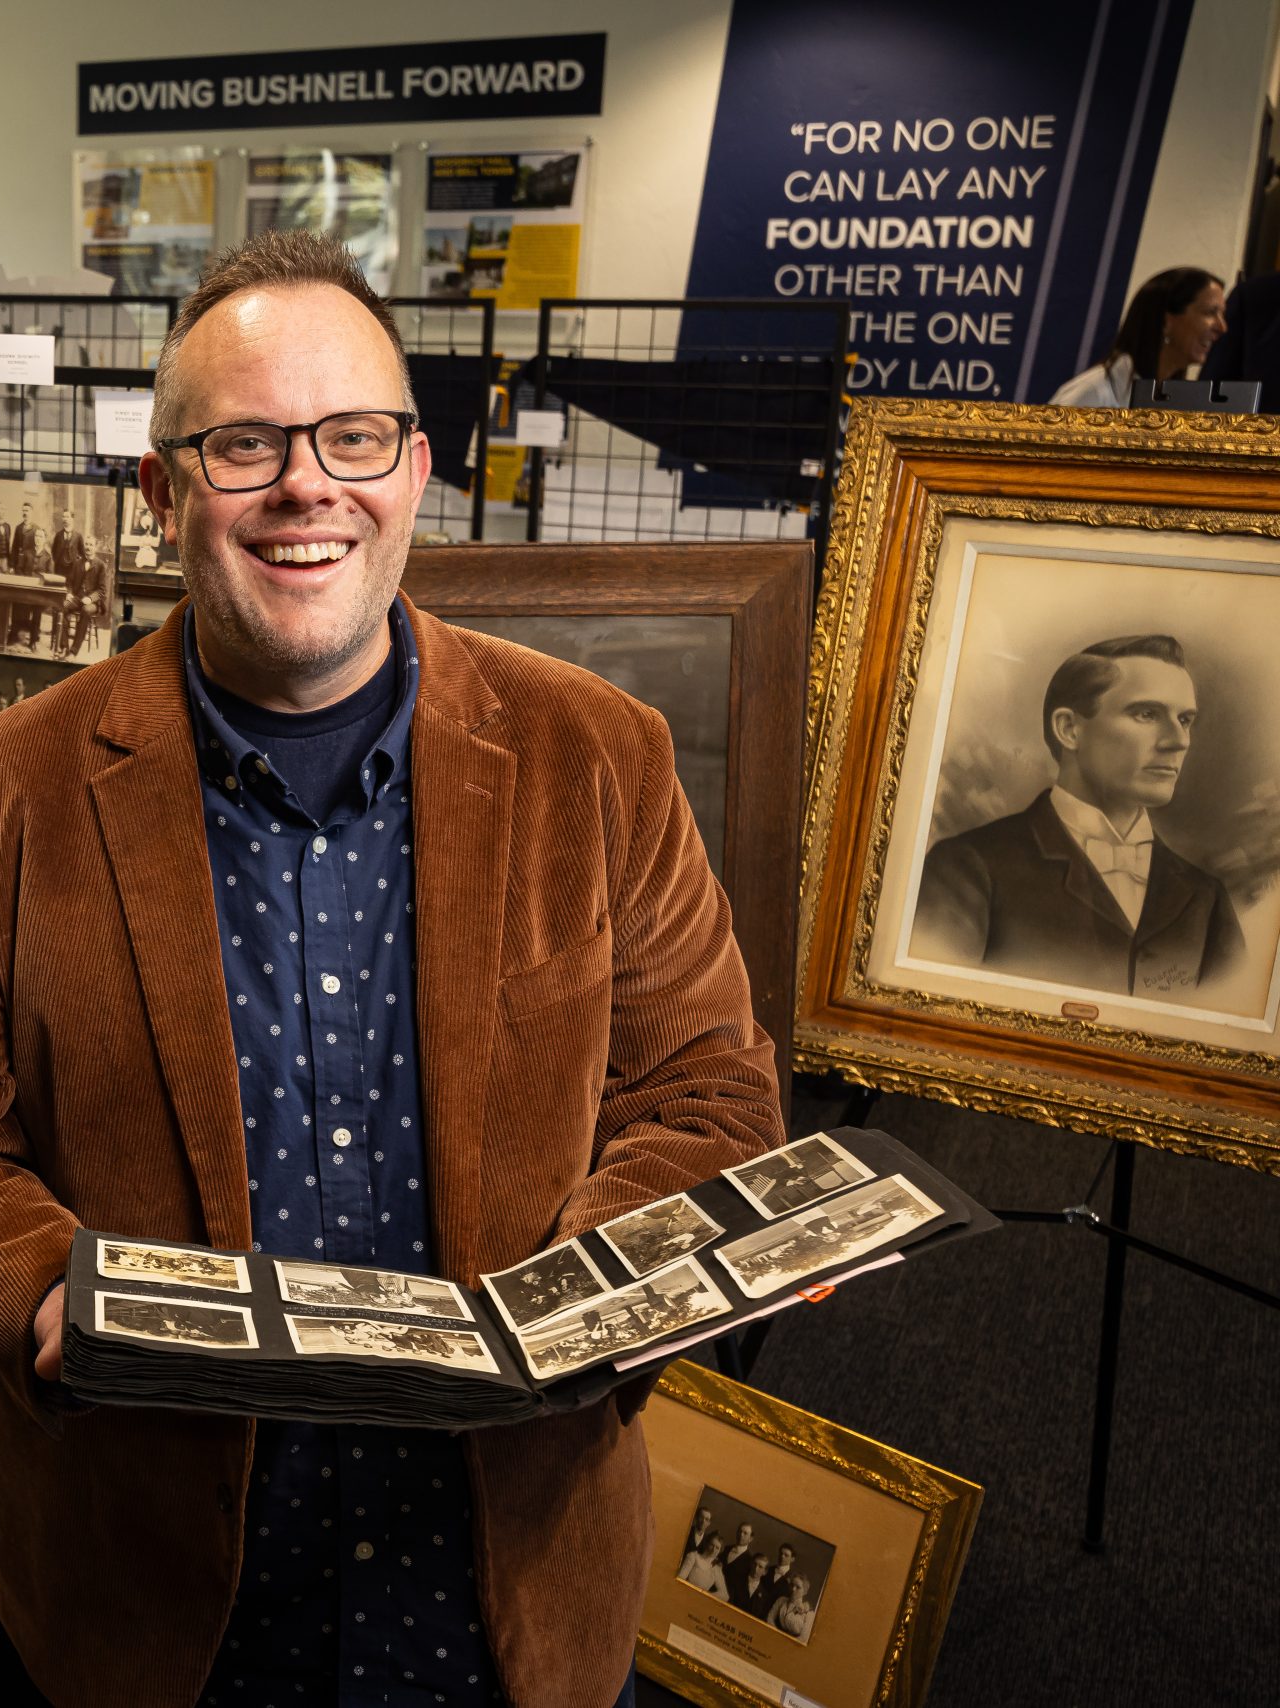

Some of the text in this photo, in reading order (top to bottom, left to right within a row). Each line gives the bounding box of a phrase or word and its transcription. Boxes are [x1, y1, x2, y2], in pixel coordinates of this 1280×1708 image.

[89, 59, 585, 114] MOVING BUSHNELL FORWARD
[791, 115, 1056, 156] “FOR NO ONE
[784, 165, 1048, 204] CAN LAY ANY
[766, 215, 1035, 250] FOUNDATION
[774, 263, 1024, 298] OTHER THAN
[849, 310, 1014, 345] THE ONE
[909, 359, 1001, 397] LAID,
[708, 1615, 736, 1634] CLASS
